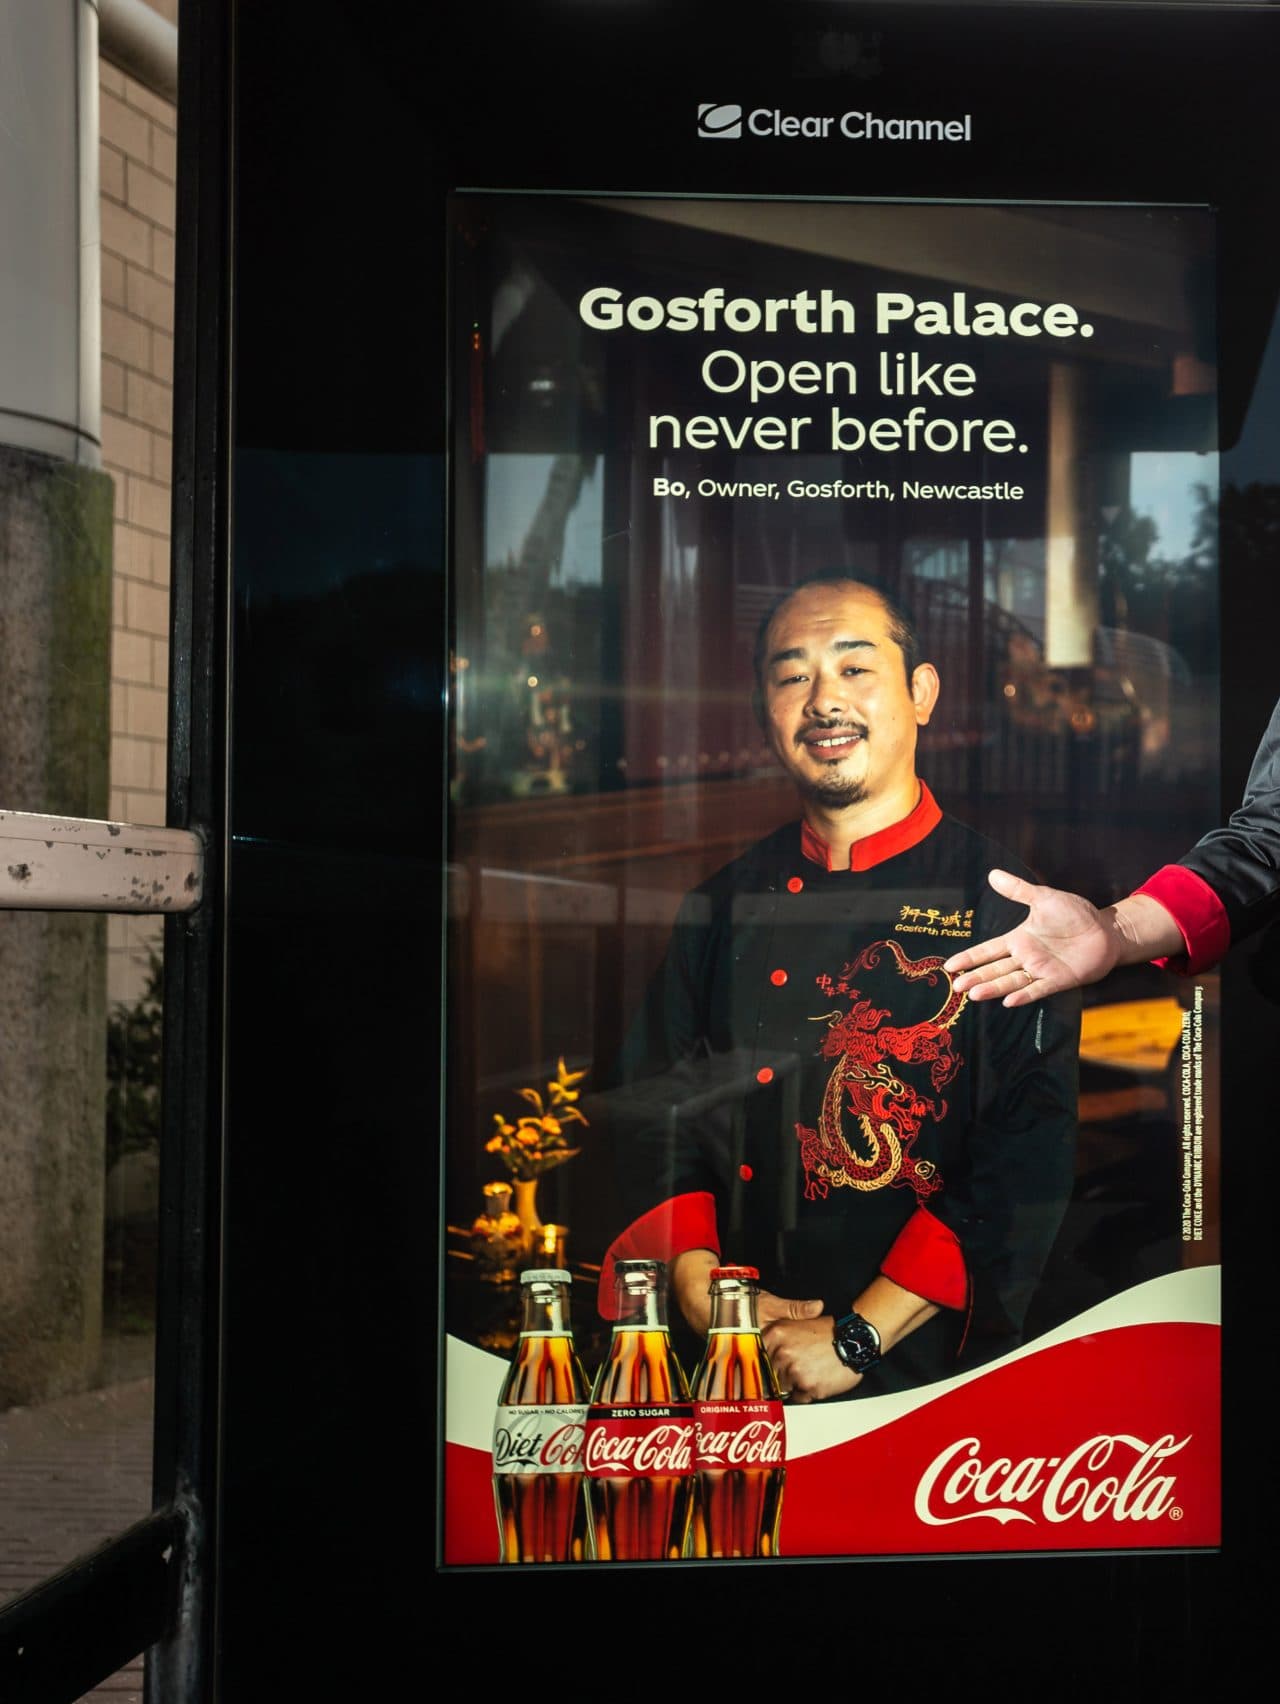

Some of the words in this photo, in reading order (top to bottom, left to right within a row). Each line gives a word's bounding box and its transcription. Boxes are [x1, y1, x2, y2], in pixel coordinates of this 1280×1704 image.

[748, 108, 835, 138] Clear
[840, 111, 972, 142] Channel
[579, 287, 856, 334] Gosforth
[876, 292, 1095, 338] Palace.
[701, 349, 857, 403] Open
[879, 352, 977, 397] like
[648, 414, 812, 451] never
[831, 406, 1029, 454] before.
[653, 477, 691, 501] Bo,
[697, 478, 780, 501] Owner,
[786, 479, 895, 502] Gosforth,
[902, 480, 1025, 501] Newcastle
[1194, 1014, 1203, 1041] Coca-Cola
[1194, 1042, 1203, 1052] The
[1194, 1096, 1203, 1124] registered
[1182, 1124, 1192, 1140] rights
[1194, 1126, 1203, 1135] are
[1182, 1142, 1192, 1150] All
[1194, 1160, 1203, 1187] DYNAMIC
[1182, 1180, 1192, 1207] Coca-Cola
[1194, 1188, 1203, 1197] the
[1194, 1199, 1203, 1209] and
[1182, 1208, 1192, 1219] The
[1194, 1211, 1203, 1226] COKE
[1182, 1220, 1192, 1234] 2020
[1194, 1228, 1203, 1240] DIET
[611, 1408, 637, 1418] ZERO
[638, 1408, 670, 1417] SUGAR
[700, 1405, 741, 1414] ORIGINAL
[743, 1405, 769, 1413] TASTE
[495, 1428, 543, 1467] Diet
[585, 1424, 694, 1473] Coca-Cola
